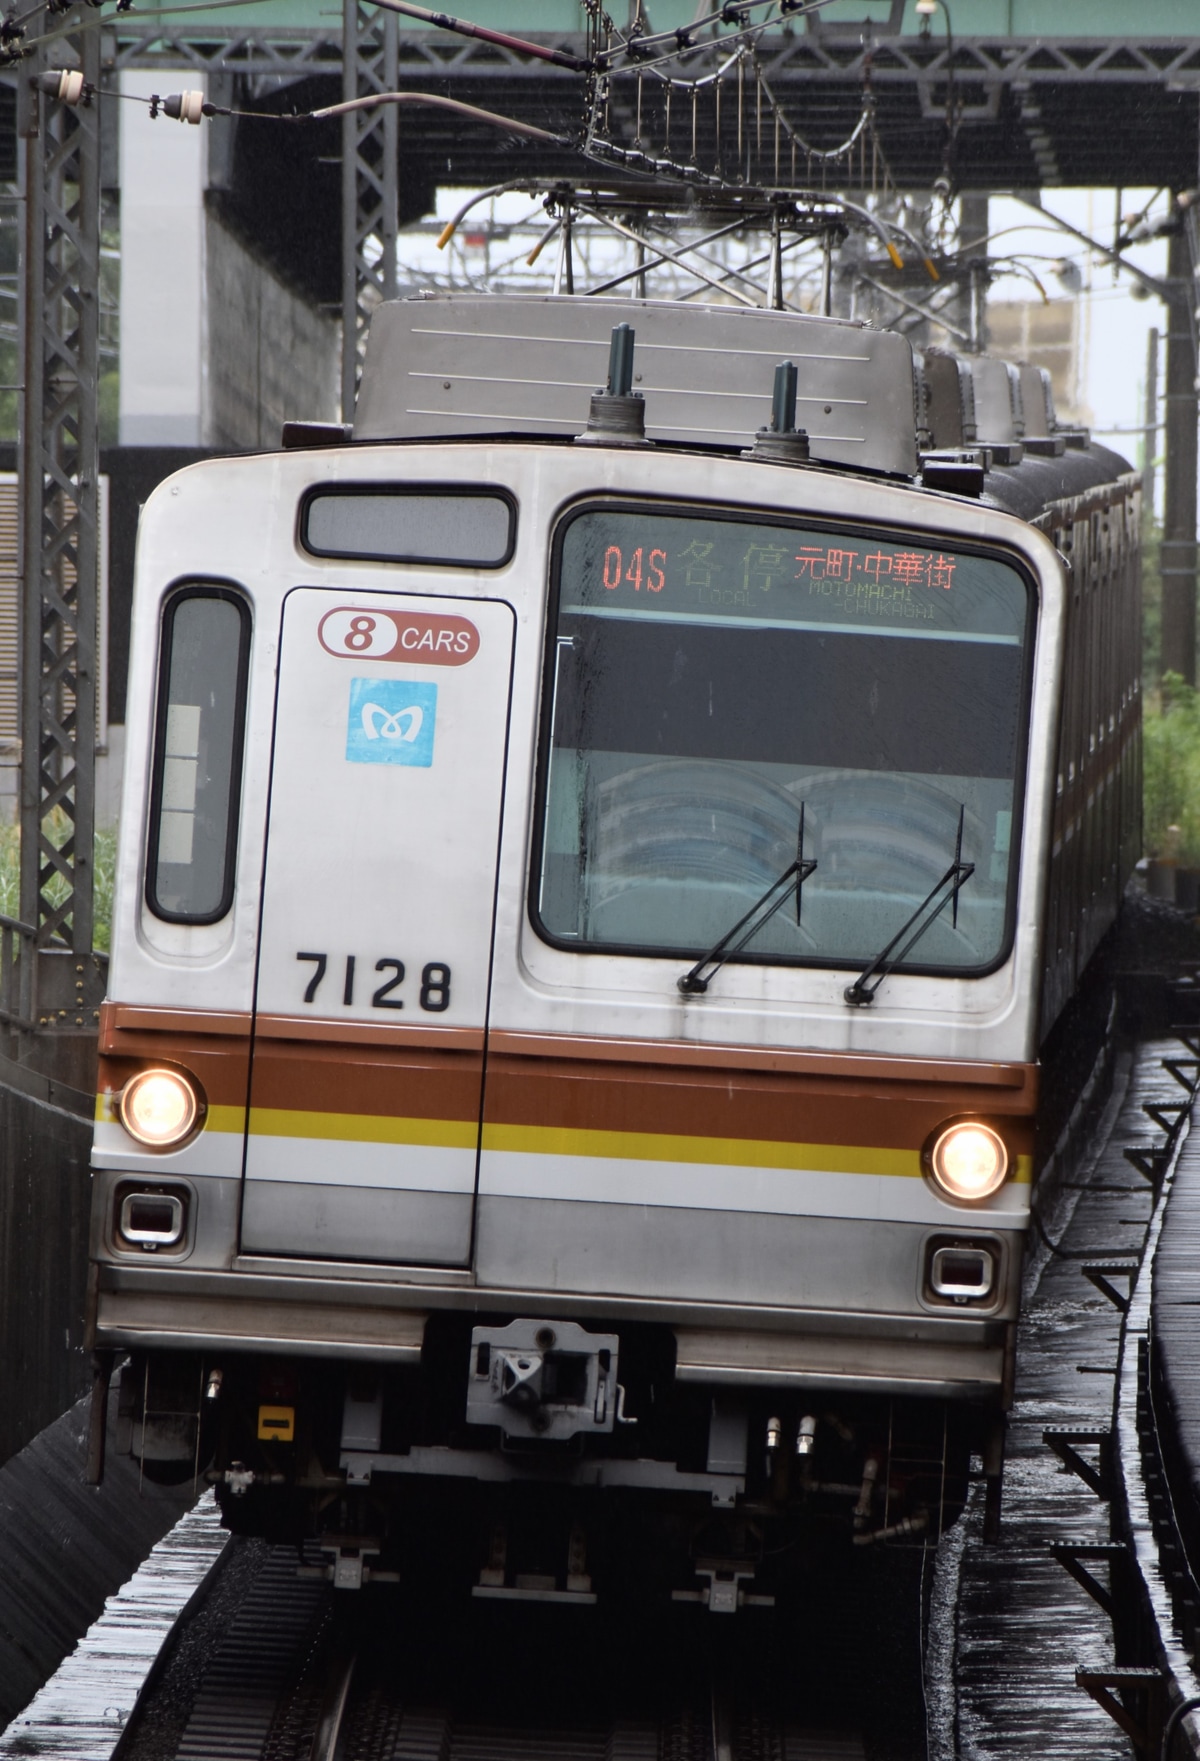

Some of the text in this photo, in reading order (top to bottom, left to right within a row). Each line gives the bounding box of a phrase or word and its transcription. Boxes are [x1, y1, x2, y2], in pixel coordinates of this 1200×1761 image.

[602, 545, 667, 593] 04S
[698, 587, 757, 607] LOCAL
[808, 579, 913, 602] MOTOMACHI
[344, 615, 471, 653] 8 CARS
[296, 951, 452, 1012] 7128
